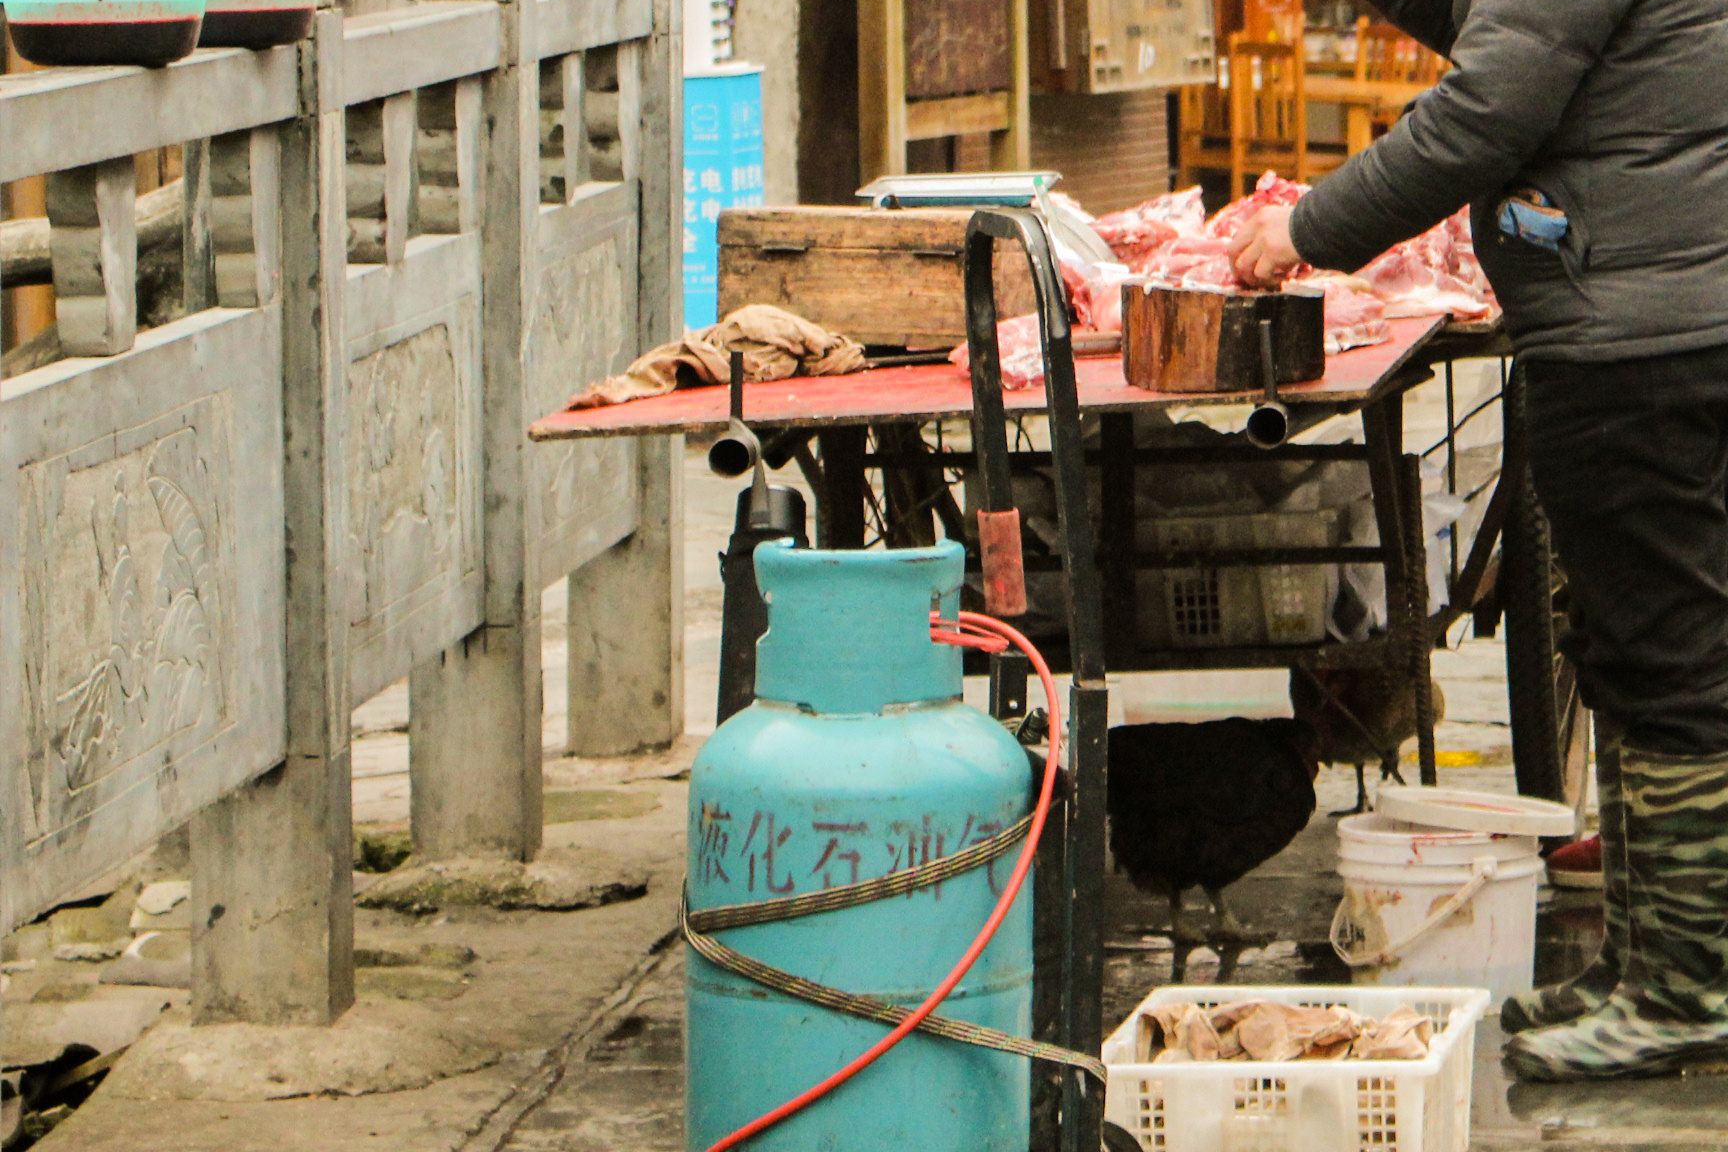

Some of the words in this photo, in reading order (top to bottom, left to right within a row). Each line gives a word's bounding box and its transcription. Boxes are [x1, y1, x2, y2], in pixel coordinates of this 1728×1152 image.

[696, 801, 1003, 902] 液化石油气
